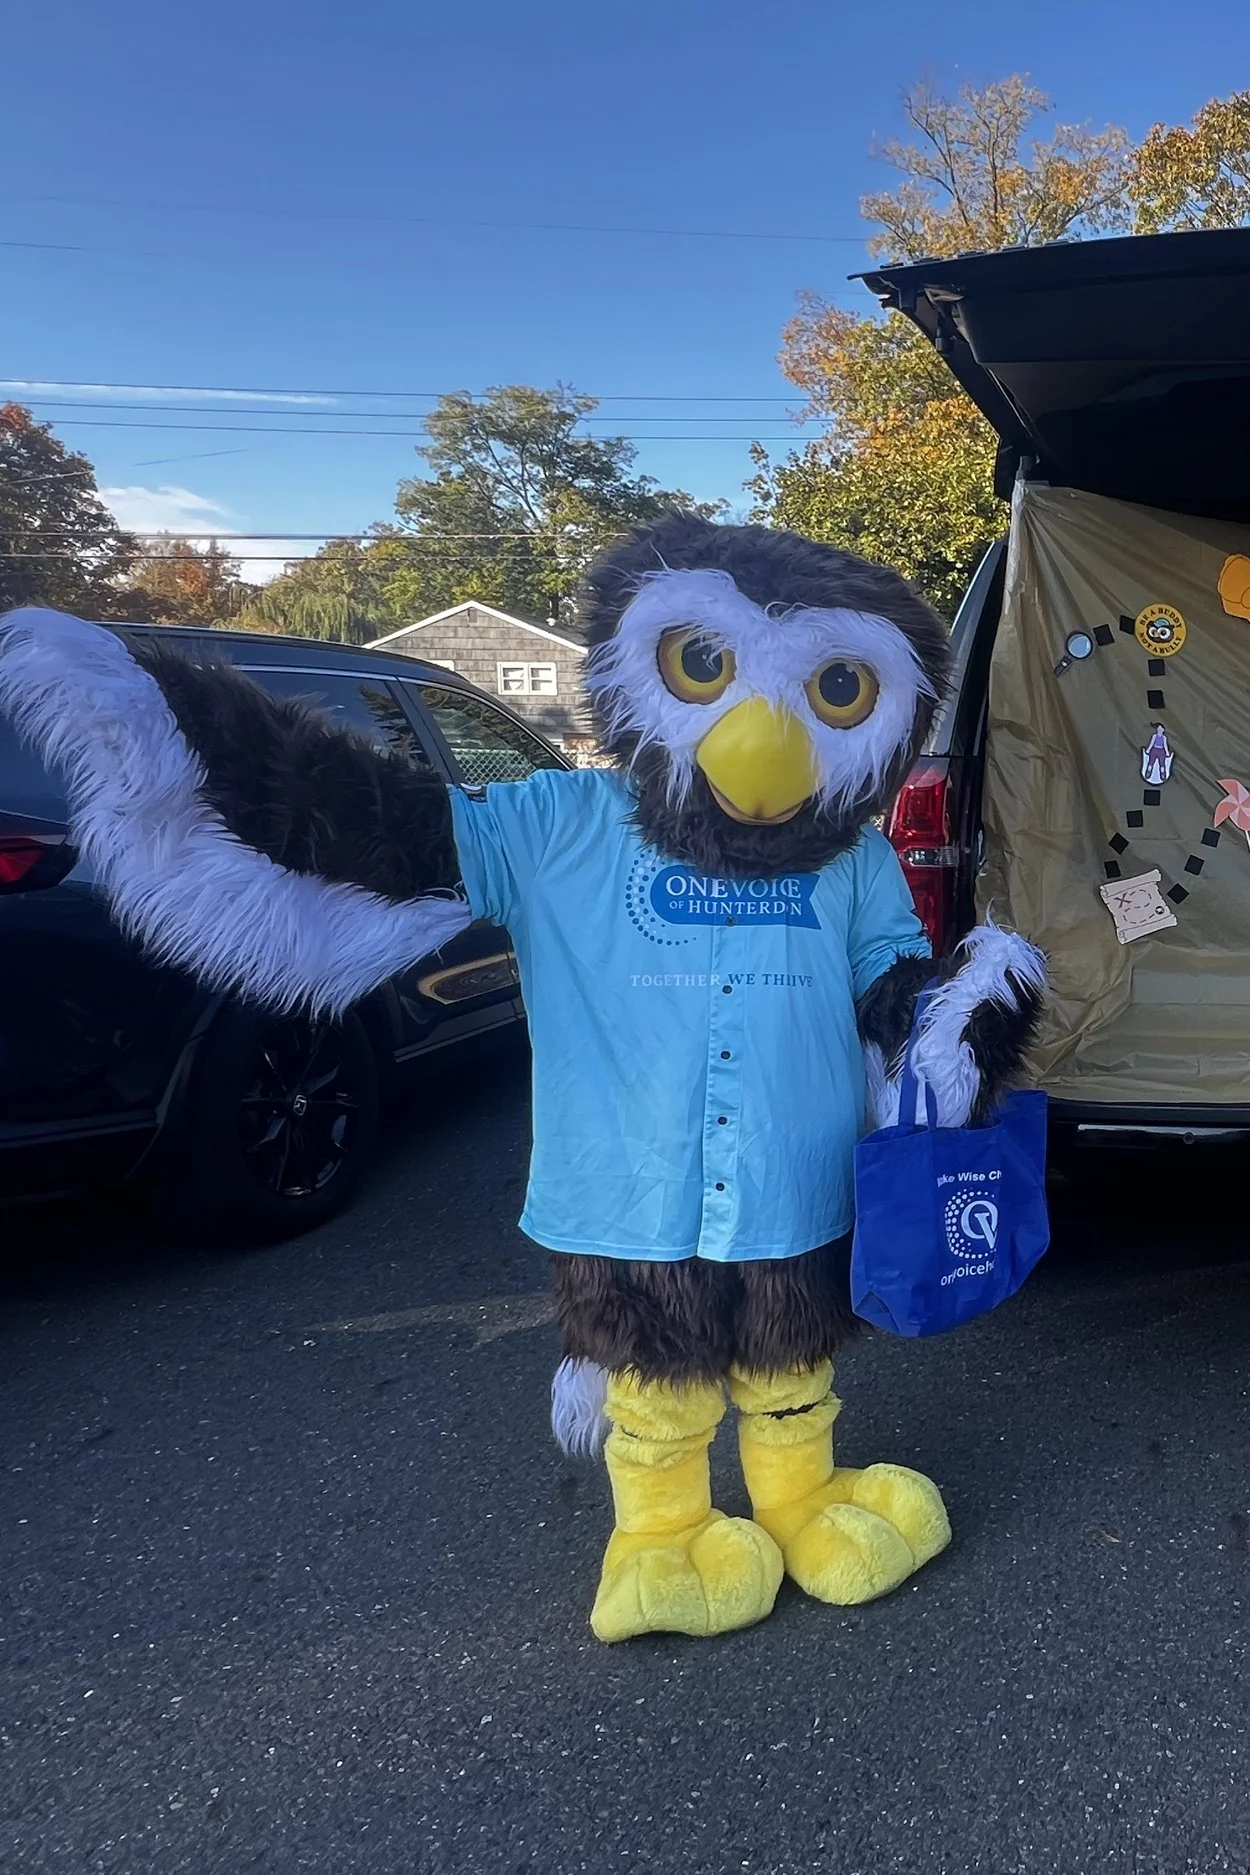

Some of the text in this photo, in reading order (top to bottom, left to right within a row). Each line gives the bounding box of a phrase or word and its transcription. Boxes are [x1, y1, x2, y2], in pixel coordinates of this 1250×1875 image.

[1140, 614, 1149, 626] BE
[1158, 607, 1182, 628] BUDDY
[1159, 637, 1182, 653] BULLY
[669, 899, 802, 916] OF HUNTERDN
[630, 973, 721, 987] TOGETHER
[728, 973, 755, 985] WE
[957, 1171, 986, 1182] Wise
